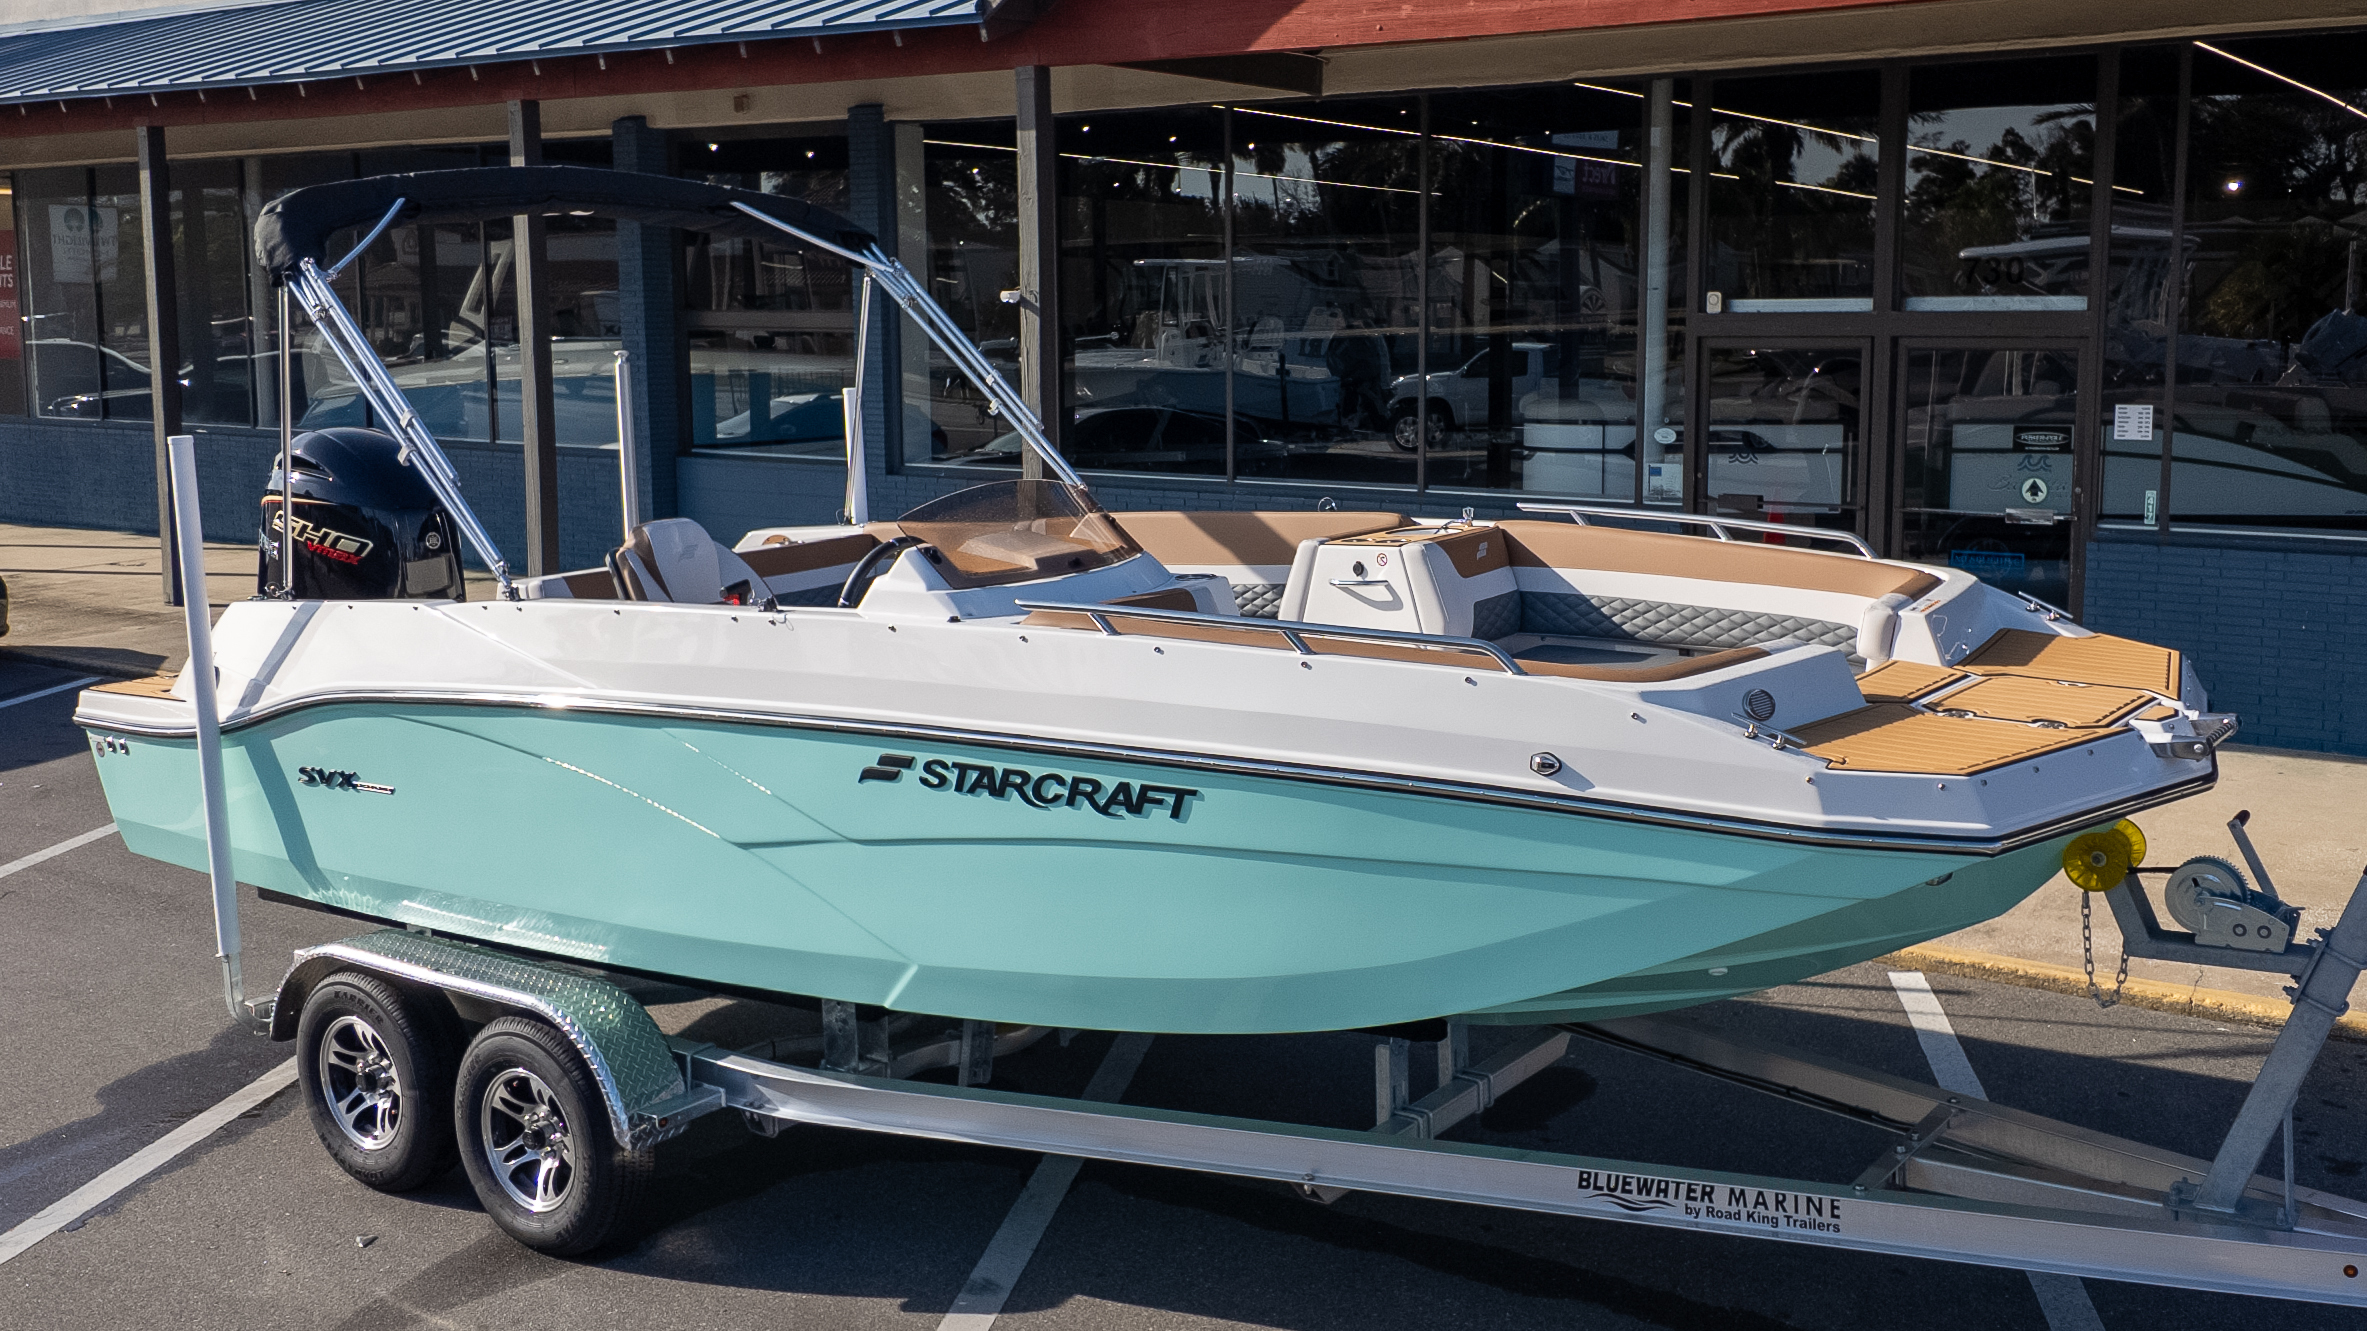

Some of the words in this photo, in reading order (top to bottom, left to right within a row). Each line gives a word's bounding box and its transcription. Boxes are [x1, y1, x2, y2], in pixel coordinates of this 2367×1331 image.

[1963, 257, 2024, 284] 730
[298, 766, 360, 789] SVX
[919, 759, 1199, 820] STARCRAFT
[1577, 1170, 1715, 1204] BLUEWATER
[1728, 1187, 1841, 1219] MARINE
[1685, 1203, 1701, 1219] by
[1706, 1206, 1741, 1221] Road
[1746, 1211, 1779, 1228] King
[1783, 1215, 1841, 1233] Trailers
